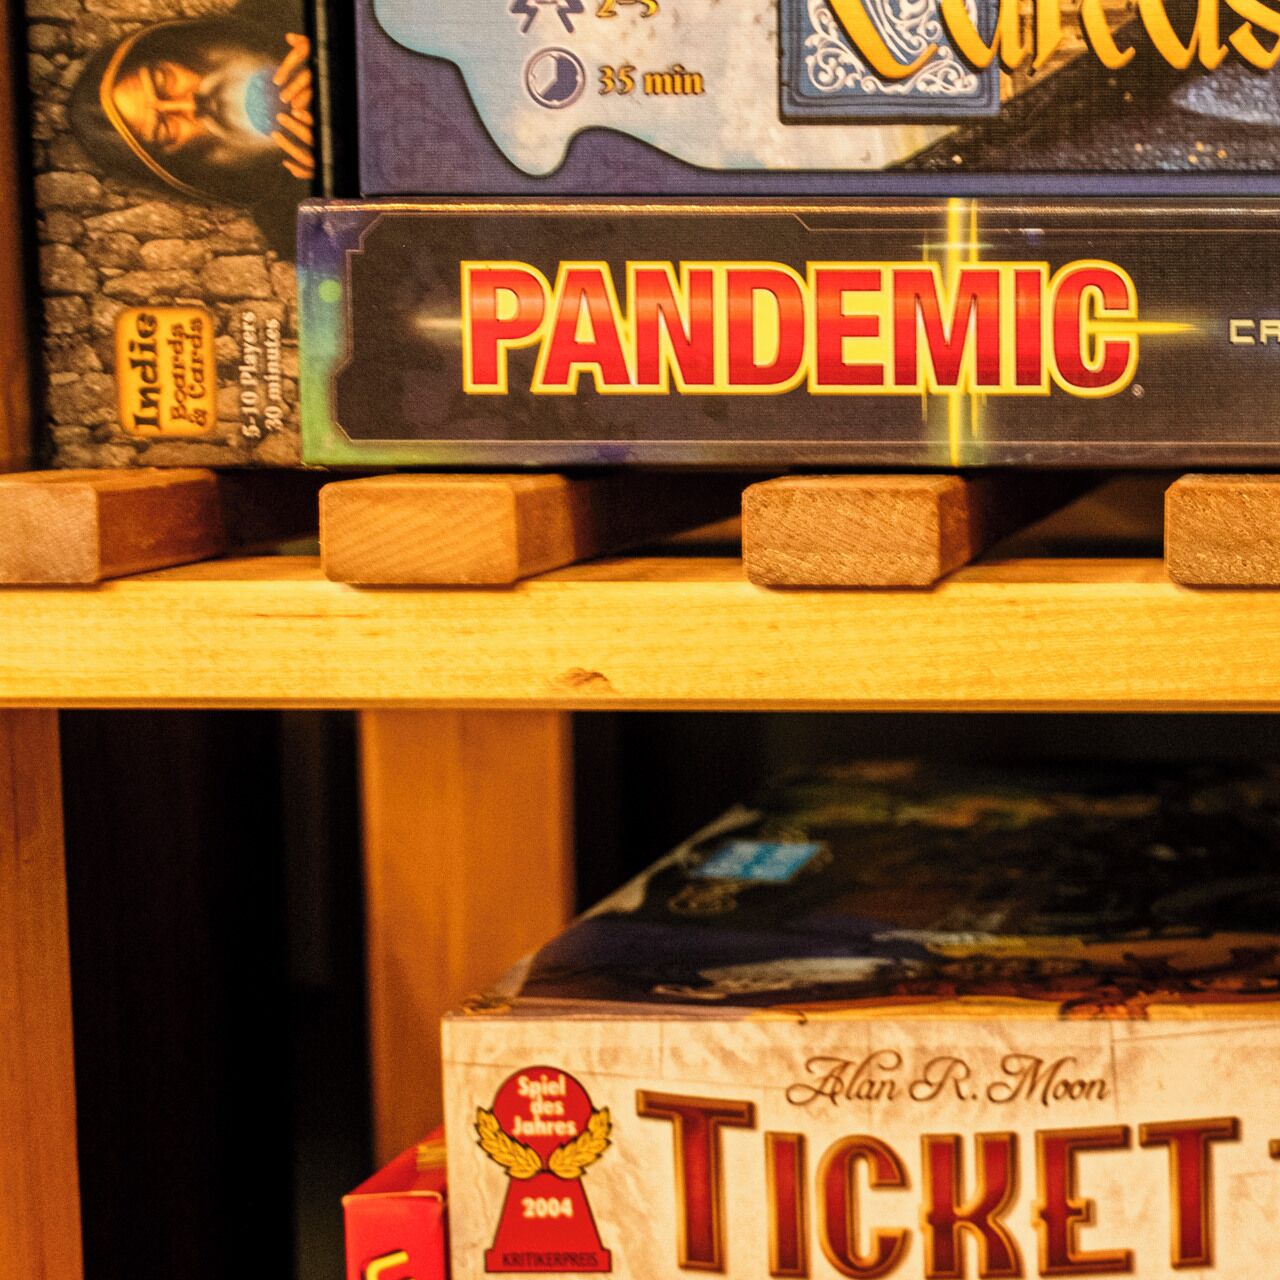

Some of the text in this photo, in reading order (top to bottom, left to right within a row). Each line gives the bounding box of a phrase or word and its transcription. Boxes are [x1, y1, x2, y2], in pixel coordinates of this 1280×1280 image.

[597, 62, 706, 97] 35 min
[262, 317, 282, 402] minutes
[460, 258, 1140, 397] PANDEMIC
[127, 311, 162, 428] Indie
[167, 322, 188, 421] Boards
[183, 317, 208, 427] & Cards
[238, 310, 263, 439] 5-10 Players
[517, 1074, 567, 1098] Spiel
[529, 1095, 565, 1116] des
[786, 1050, 1118, 1110] Alan R. Moon
[511, 1114, 578, 1137] Jahres
[521, 1196, 574, 1218] 2004
